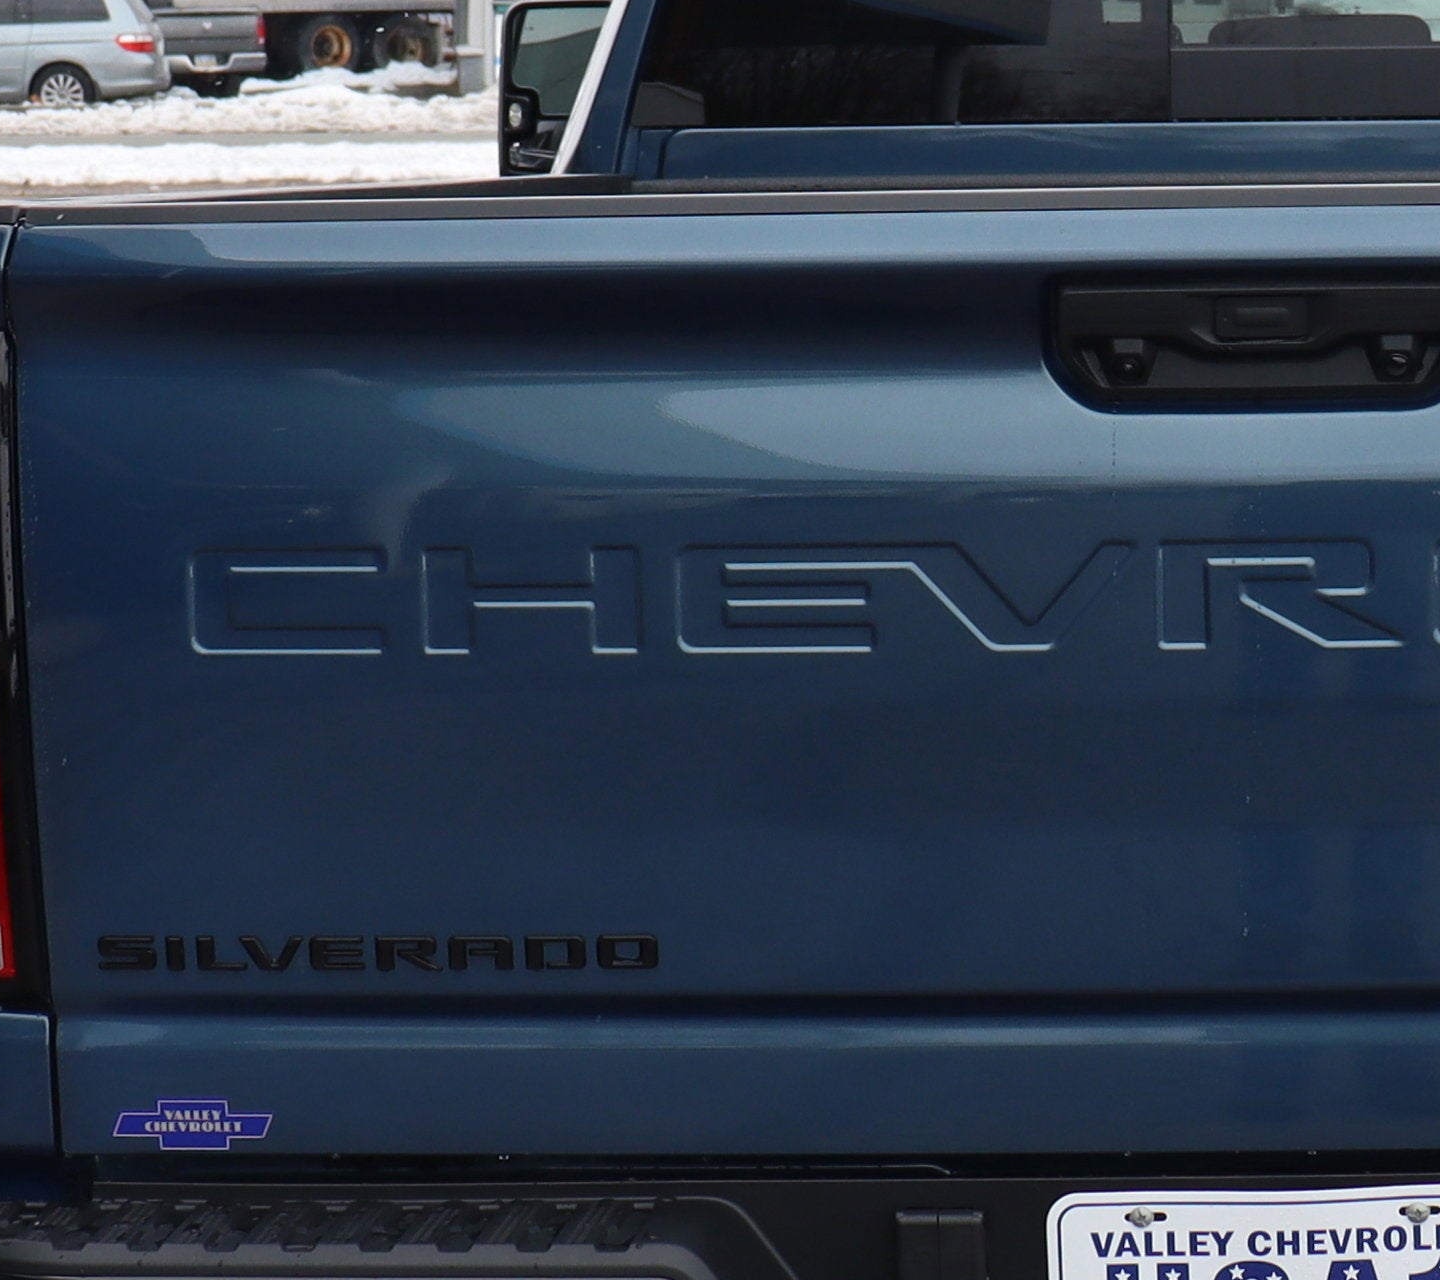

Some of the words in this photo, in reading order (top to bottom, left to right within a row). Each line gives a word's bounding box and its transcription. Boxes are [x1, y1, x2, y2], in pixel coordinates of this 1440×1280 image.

[97, 934, 661, 972] SILVERADO
[164, 1110, 222, 1121] VALLEY
[144, 1120, 243, 1132] CHEVROLET
[1090, 1230, 1235, 1258] VALLEY
